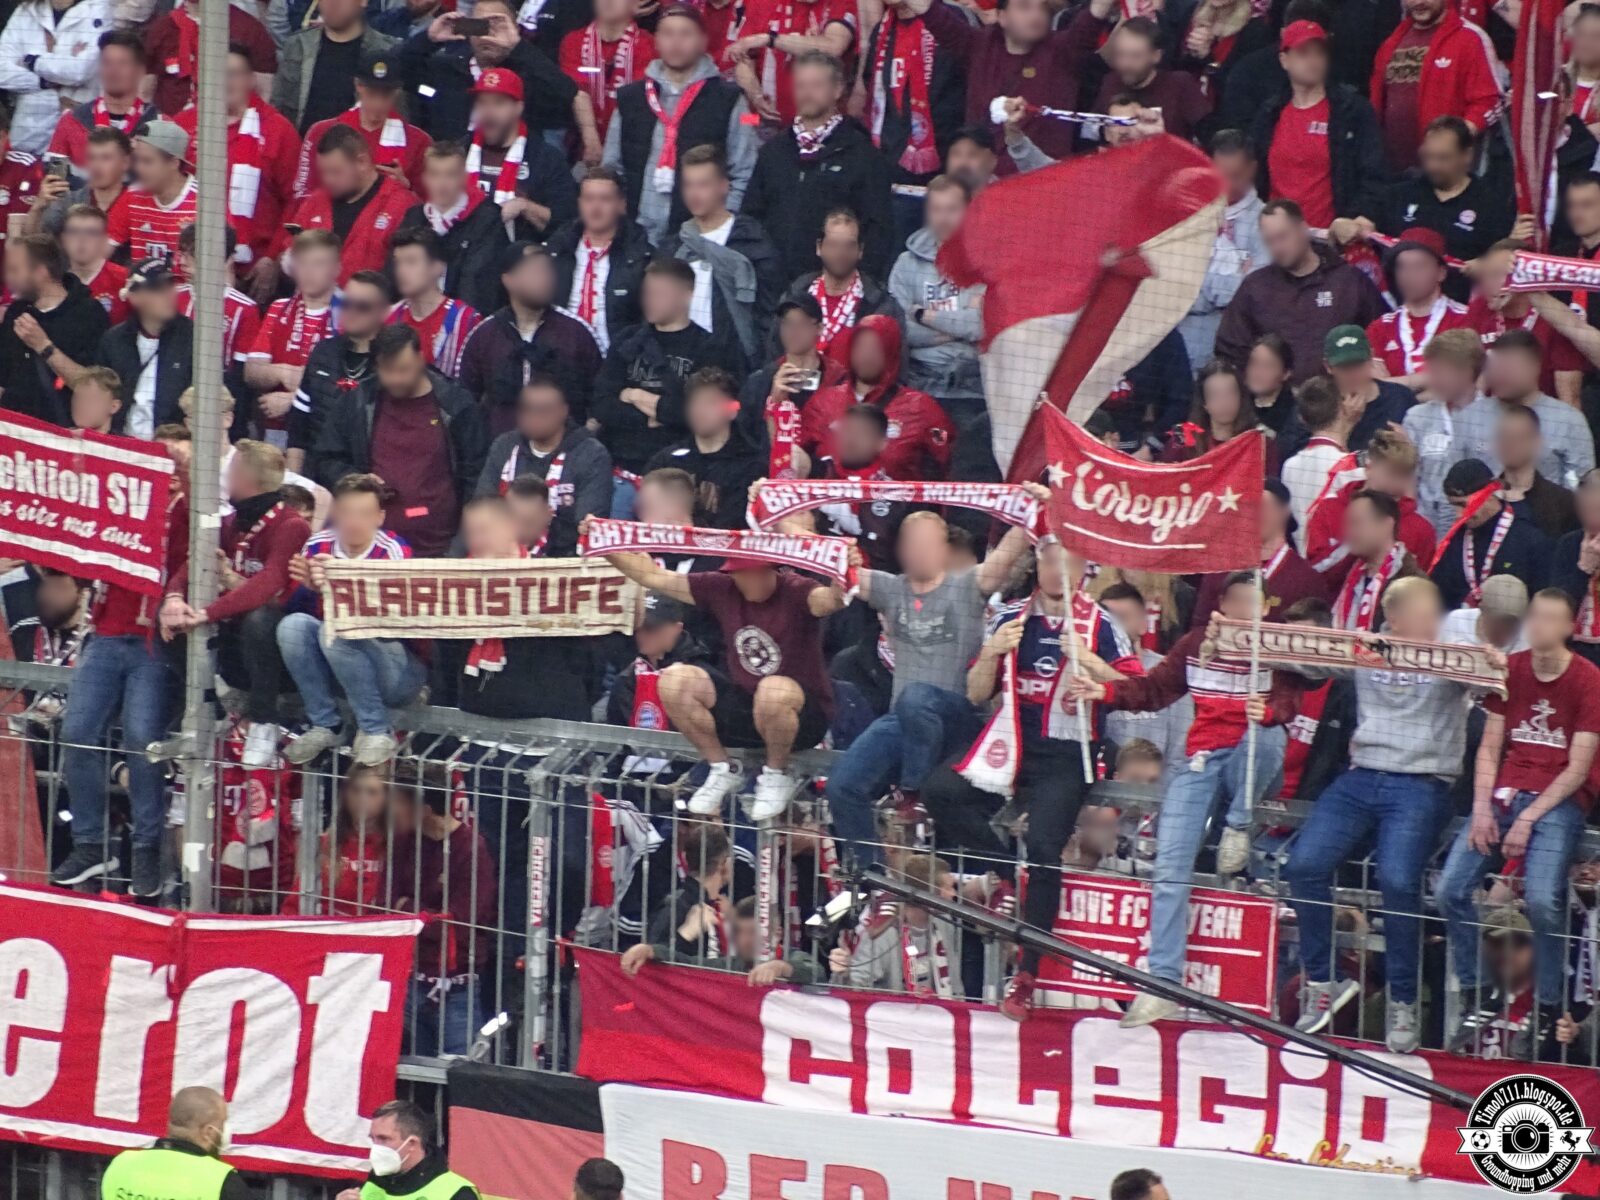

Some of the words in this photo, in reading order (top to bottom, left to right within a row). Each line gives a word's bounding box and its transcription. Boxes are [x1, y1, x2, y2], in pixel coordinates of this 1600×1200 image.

[107, 472, 153, 521] SV
[1058, 887, 1114, 924] LOVE
[1118, 894, 1150, 928] FC
[1187, 902, 1244, 940] YERN
